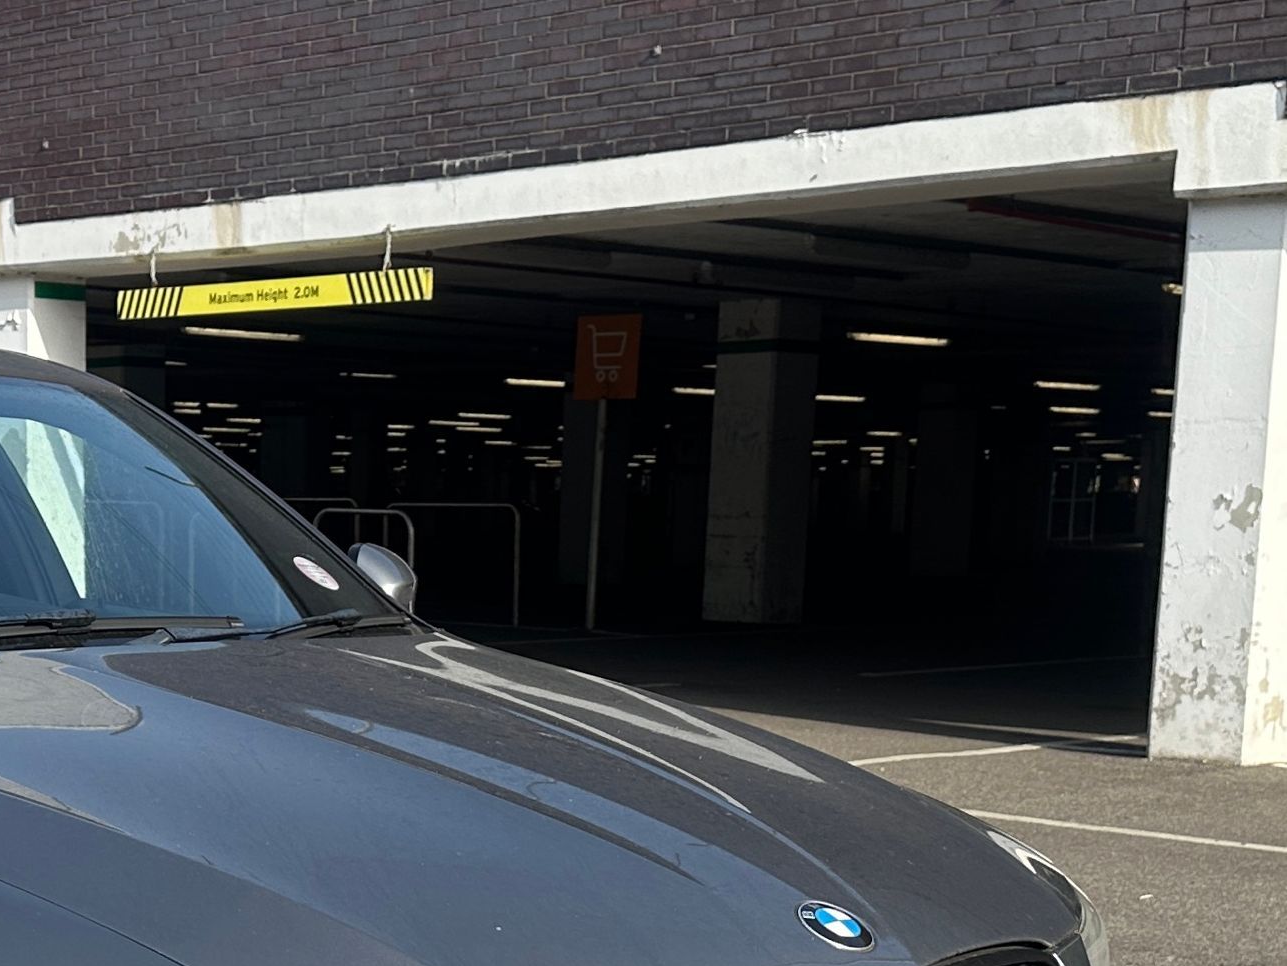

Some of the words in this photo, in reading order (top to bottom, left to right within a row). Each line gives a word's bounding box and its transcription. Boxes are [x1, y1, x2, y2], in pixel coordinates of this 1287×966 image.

[209, 291, 253, 304] Maximum
[256, 287, 288, 303] Height
[294, 285, 319, 299] 2.0M
